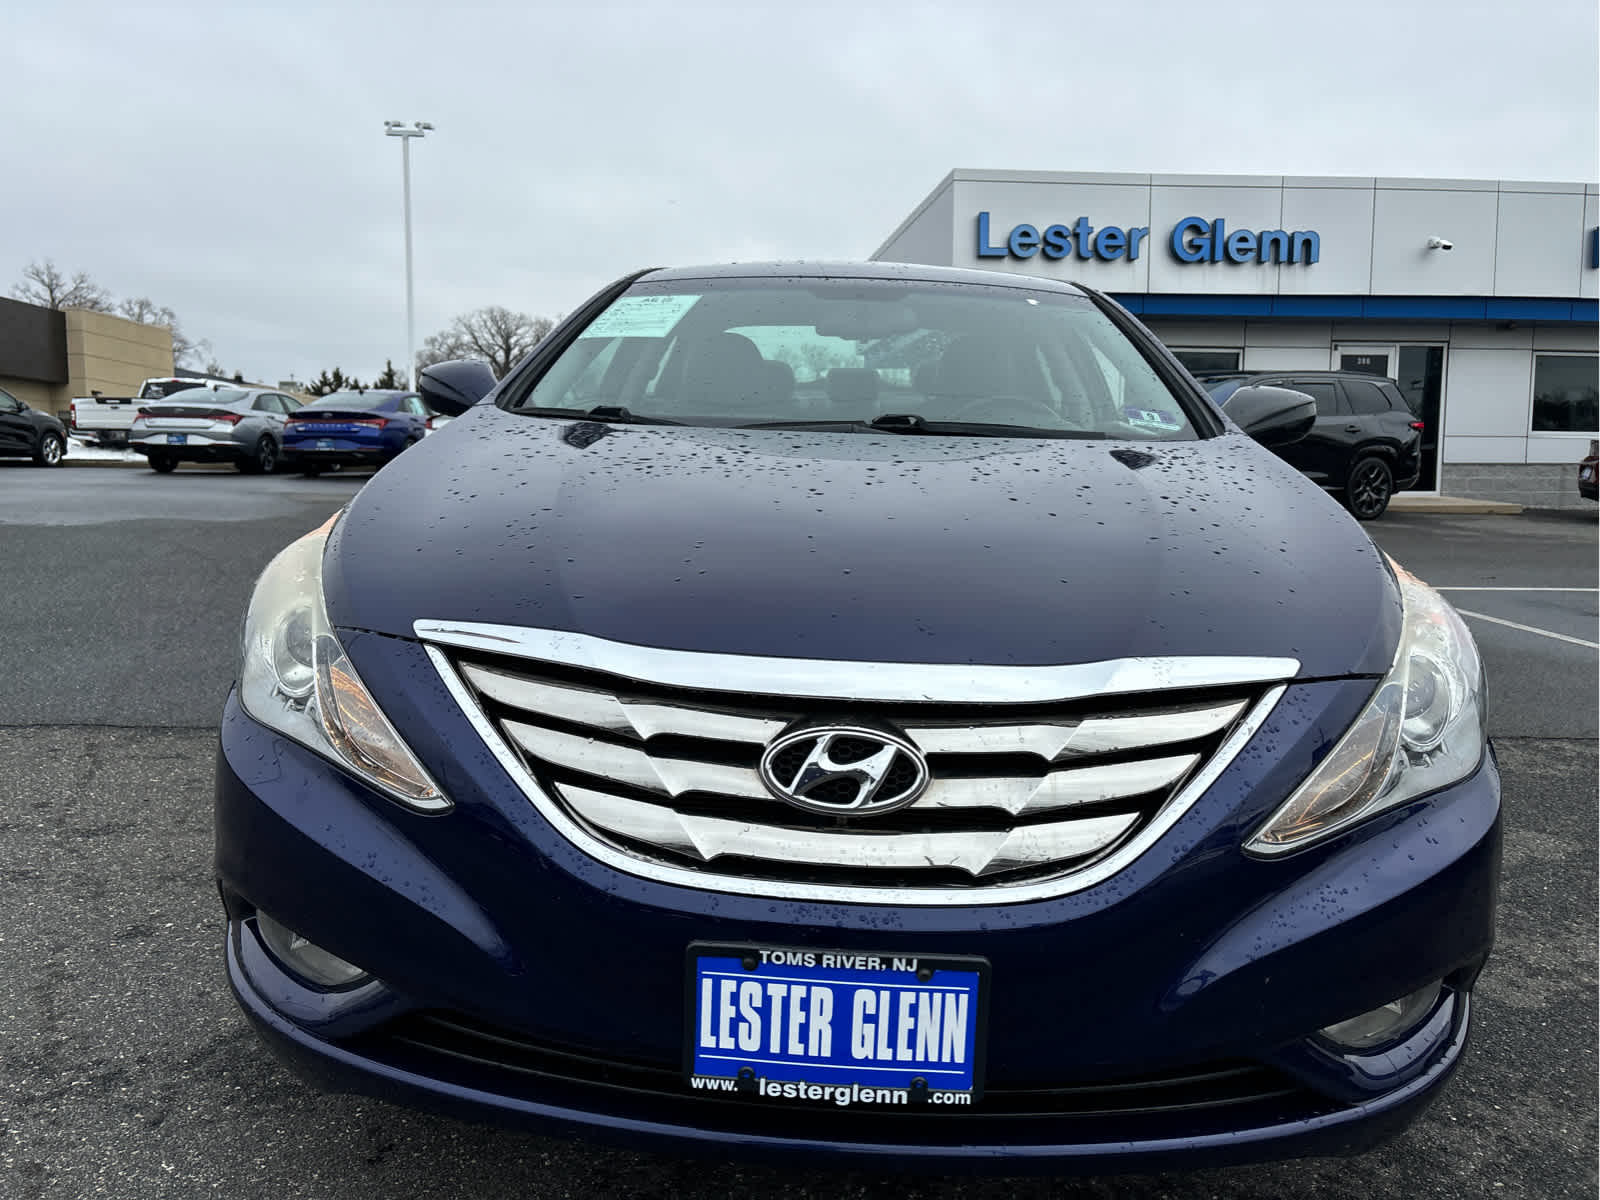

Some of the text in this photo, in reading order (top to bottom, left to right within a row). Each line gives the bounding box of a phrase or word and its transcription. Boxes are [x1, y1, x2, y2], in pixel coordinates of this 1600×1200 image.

[978, 211, 1320, 265] Lester Glenn
[759, 950, 919, 972] TOMS RIVER, NJ
[699, 977, 969, 1064] LESTER GLENN
[690, 1076, 972, 1106] www. lesterglenn .com
